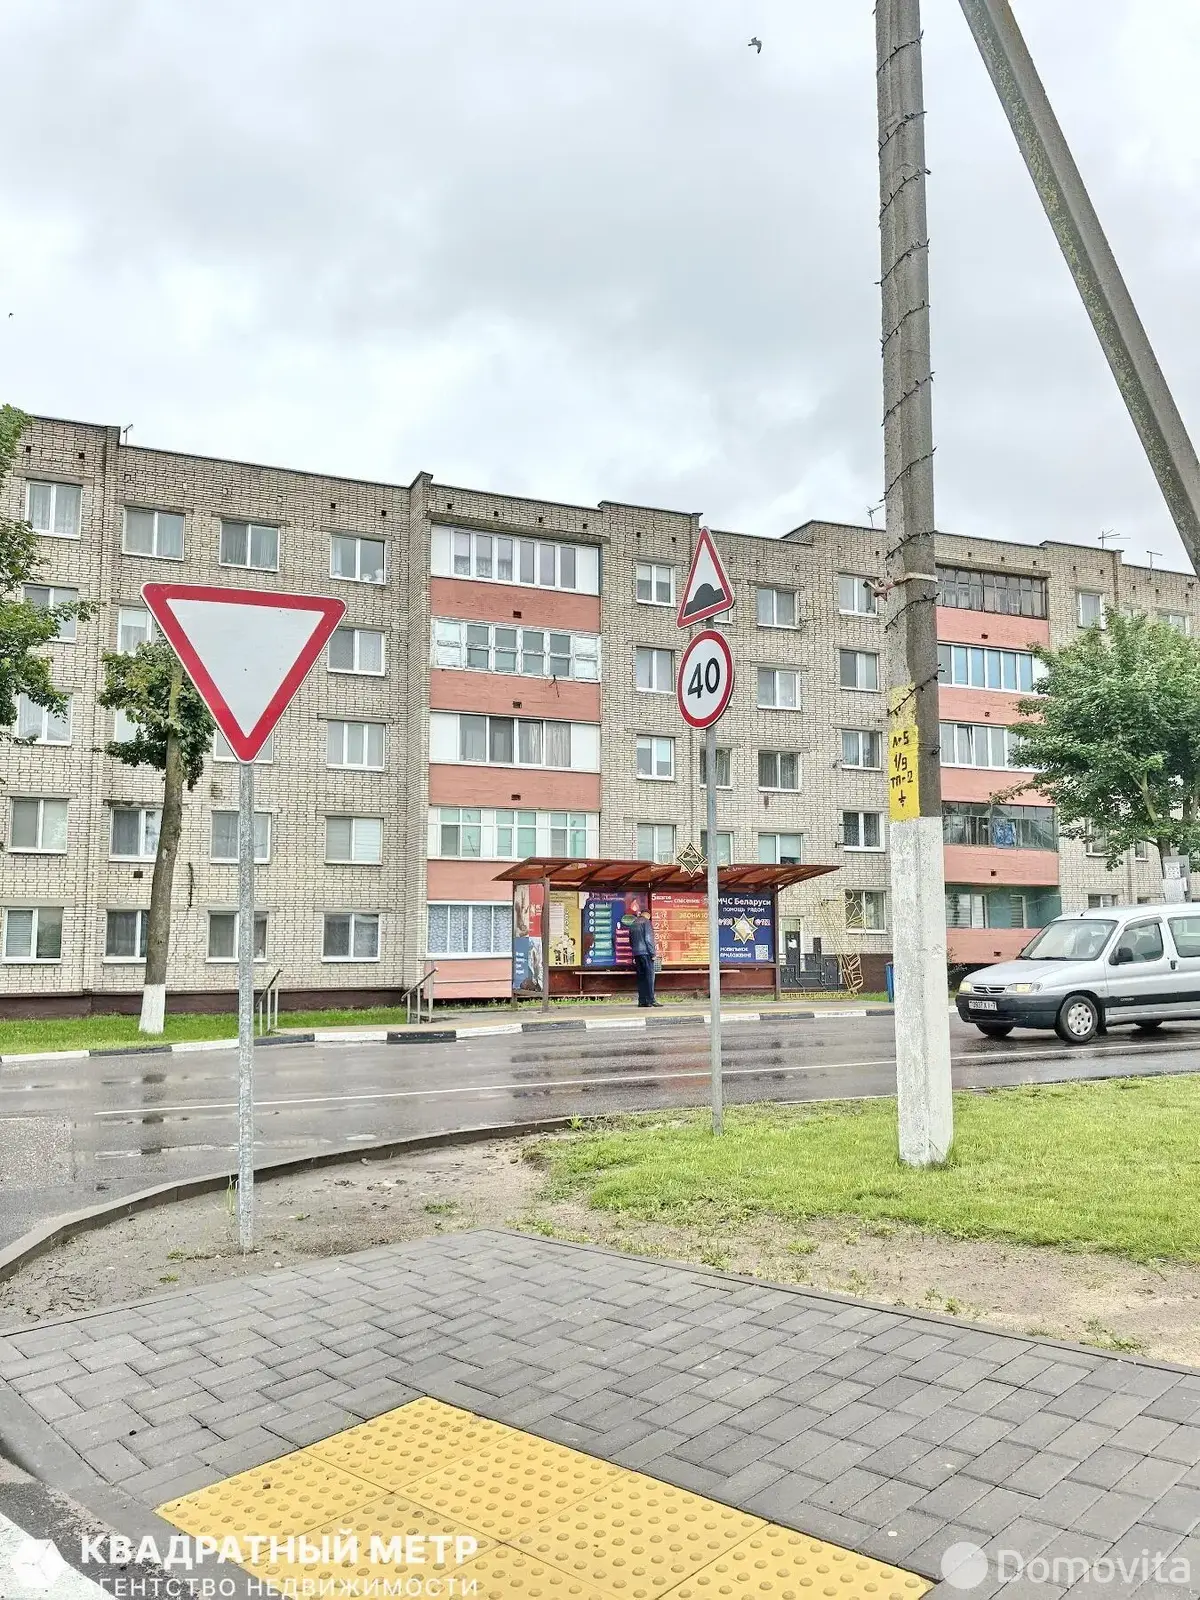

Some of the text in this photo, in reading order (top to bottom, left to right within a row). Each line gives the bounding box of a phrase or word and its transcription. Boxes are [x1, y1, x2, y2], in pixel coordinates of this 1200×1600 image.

[688, 657, 720, 698] 40
[651, 893, 657, 904] 5
[734, 897, 772, 906] Беларуси
